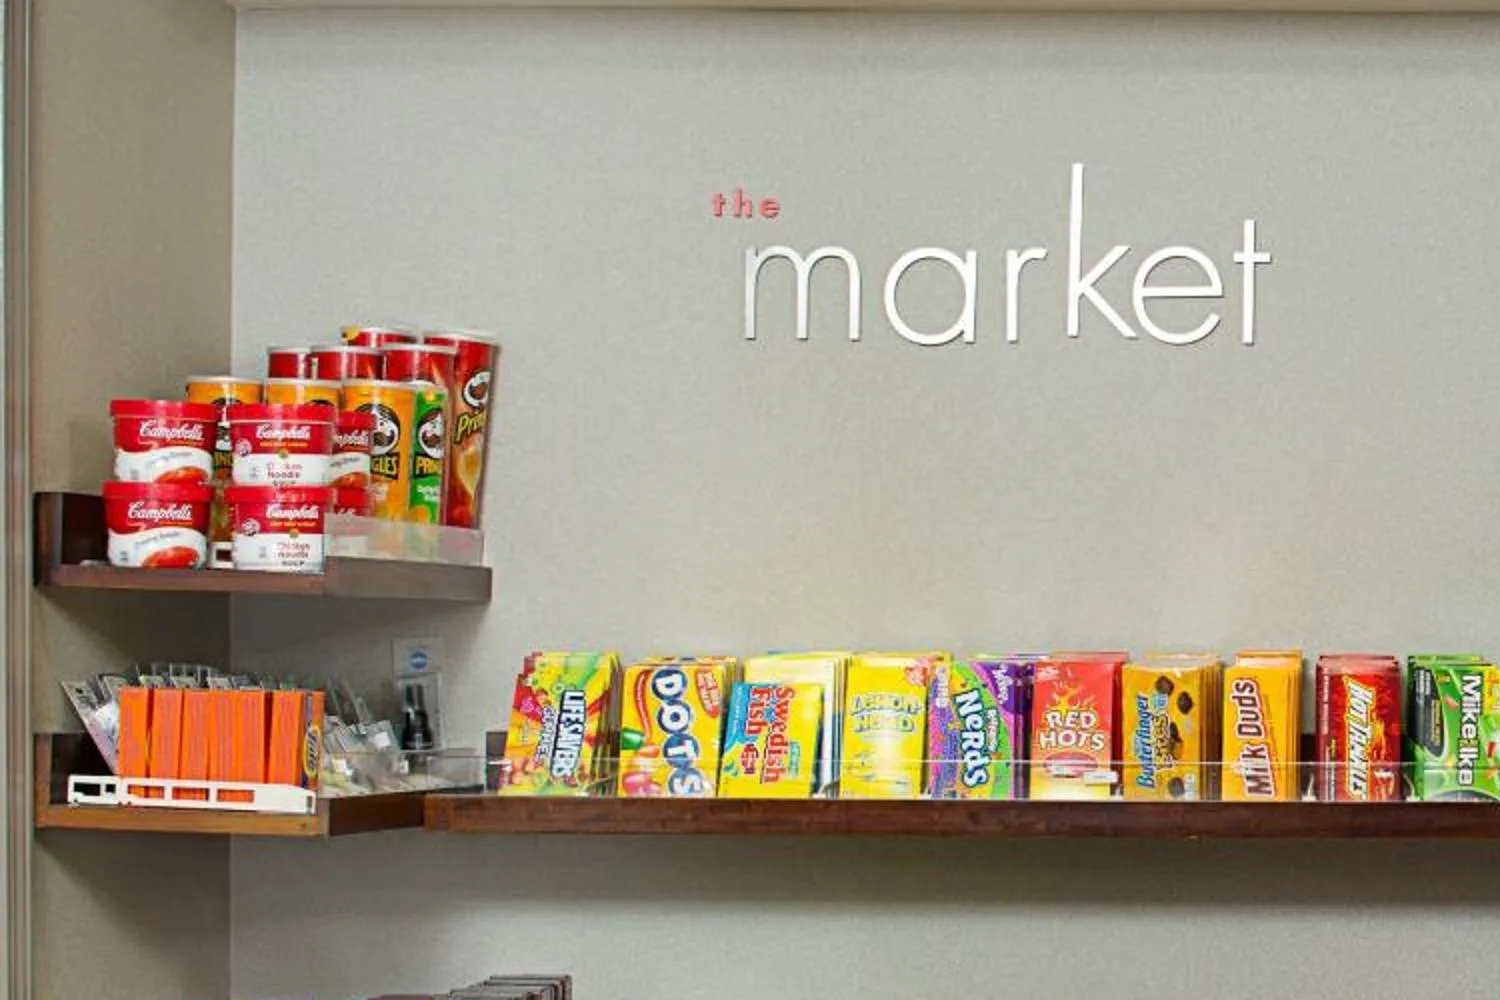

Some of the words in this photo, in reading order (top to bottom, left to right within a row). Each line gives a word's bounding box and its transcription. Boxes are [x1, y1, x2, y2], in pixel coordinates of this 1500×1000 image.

[711, 188, 781, 218] the
[744, 162, 1273, 346] market
[371, 455, 399, 477] GLES
[653, 669, 701, 796] DOTS
[745, 687, 772, 736] Fish
[1046, 710, 1097, 729] RED
[1231, 680, 1262, 737] Duds
[1461, 674, 1482, 738] Mike
[762, 687, 796, 783] Swedish
[1039, 730, 1105, 750] HOTS
[1134, 694, 1155, 788] Butterfinger
[1459, 747, 1478, 785] Ike
